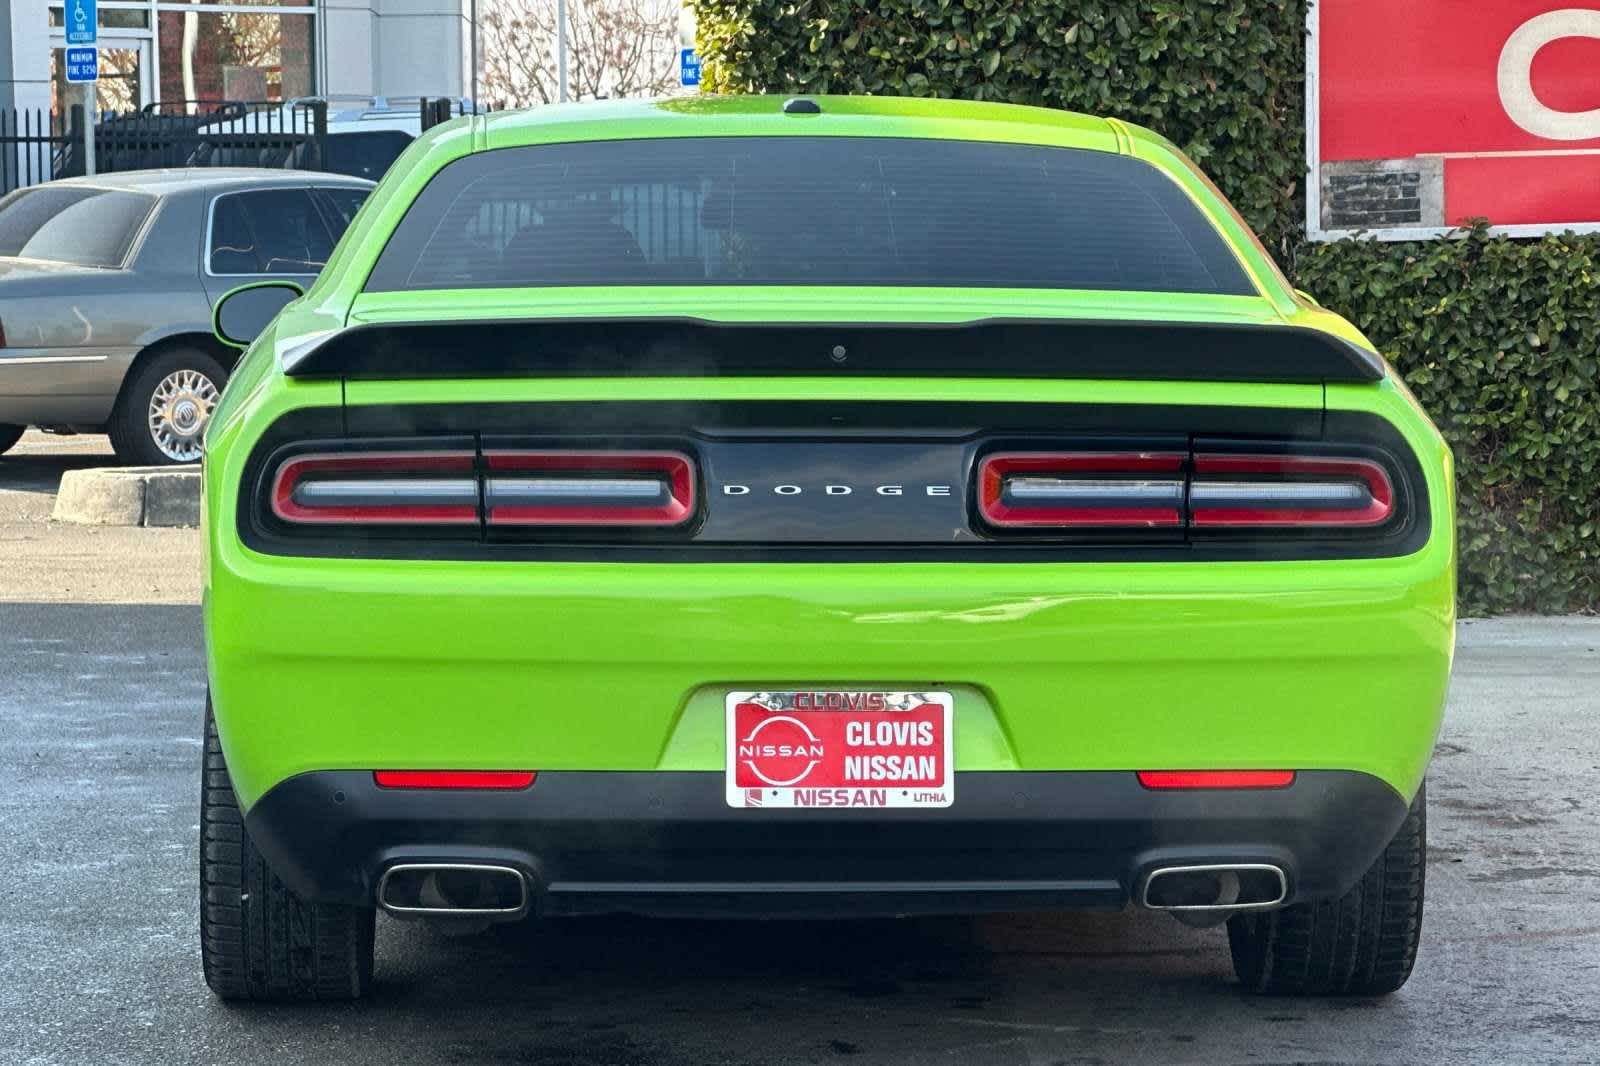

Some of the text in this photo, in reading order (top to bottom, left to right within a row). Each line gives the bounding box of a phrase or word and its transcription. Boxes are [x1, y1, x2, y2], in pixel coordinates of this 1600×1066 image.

[70, 53, 93, 62] MINIMUM
[69, 64, 97, 75] FINE $250
[723, 485, 951, 496] DODGE
[794, 693, 886, 710] CLOVIS
[846, 721, 934, 746] CLOVIS
[740, 745, 824, 757] NISSAN
[844, 755, 936, 780] NISSAN
[793, 789, 887, 806] NISSAN
[913, 793, 947, 803] LITHIA
